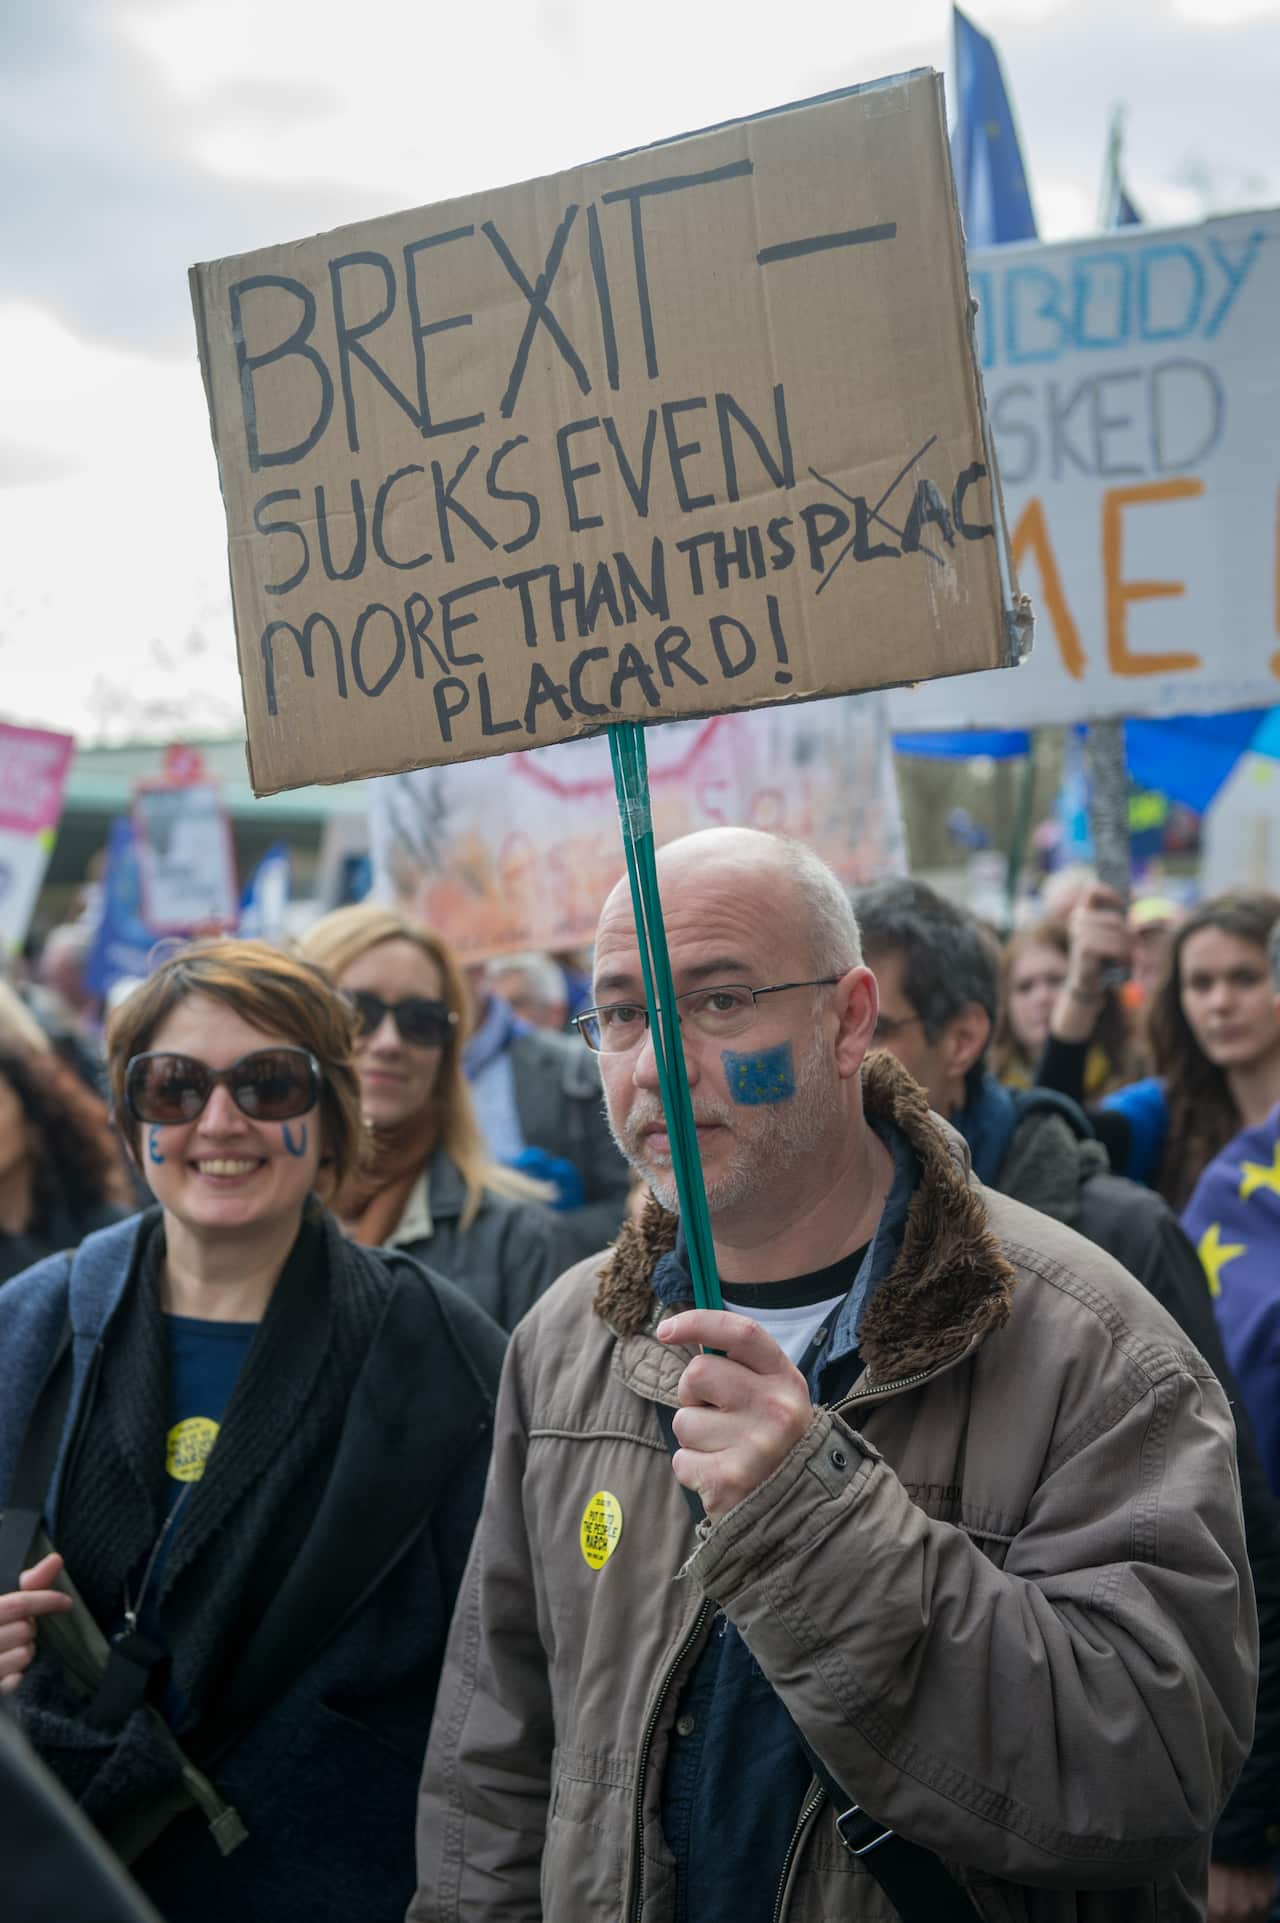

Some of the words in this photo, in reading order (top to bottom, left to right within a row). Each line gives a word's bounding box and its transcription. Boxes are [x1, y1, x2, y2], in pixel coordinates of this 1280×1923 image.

[228, 158, 753, 474] BREXIT
[253, 434, 541, 595] SUCKS
[556, 383, 796, 533] EVEN
[261, 576, 502, 717] MORE
[501, 536, 671, 648] THAN
[676, 515, 796, 596] THIS
[432, 594, 795, 742] PLACARD!
